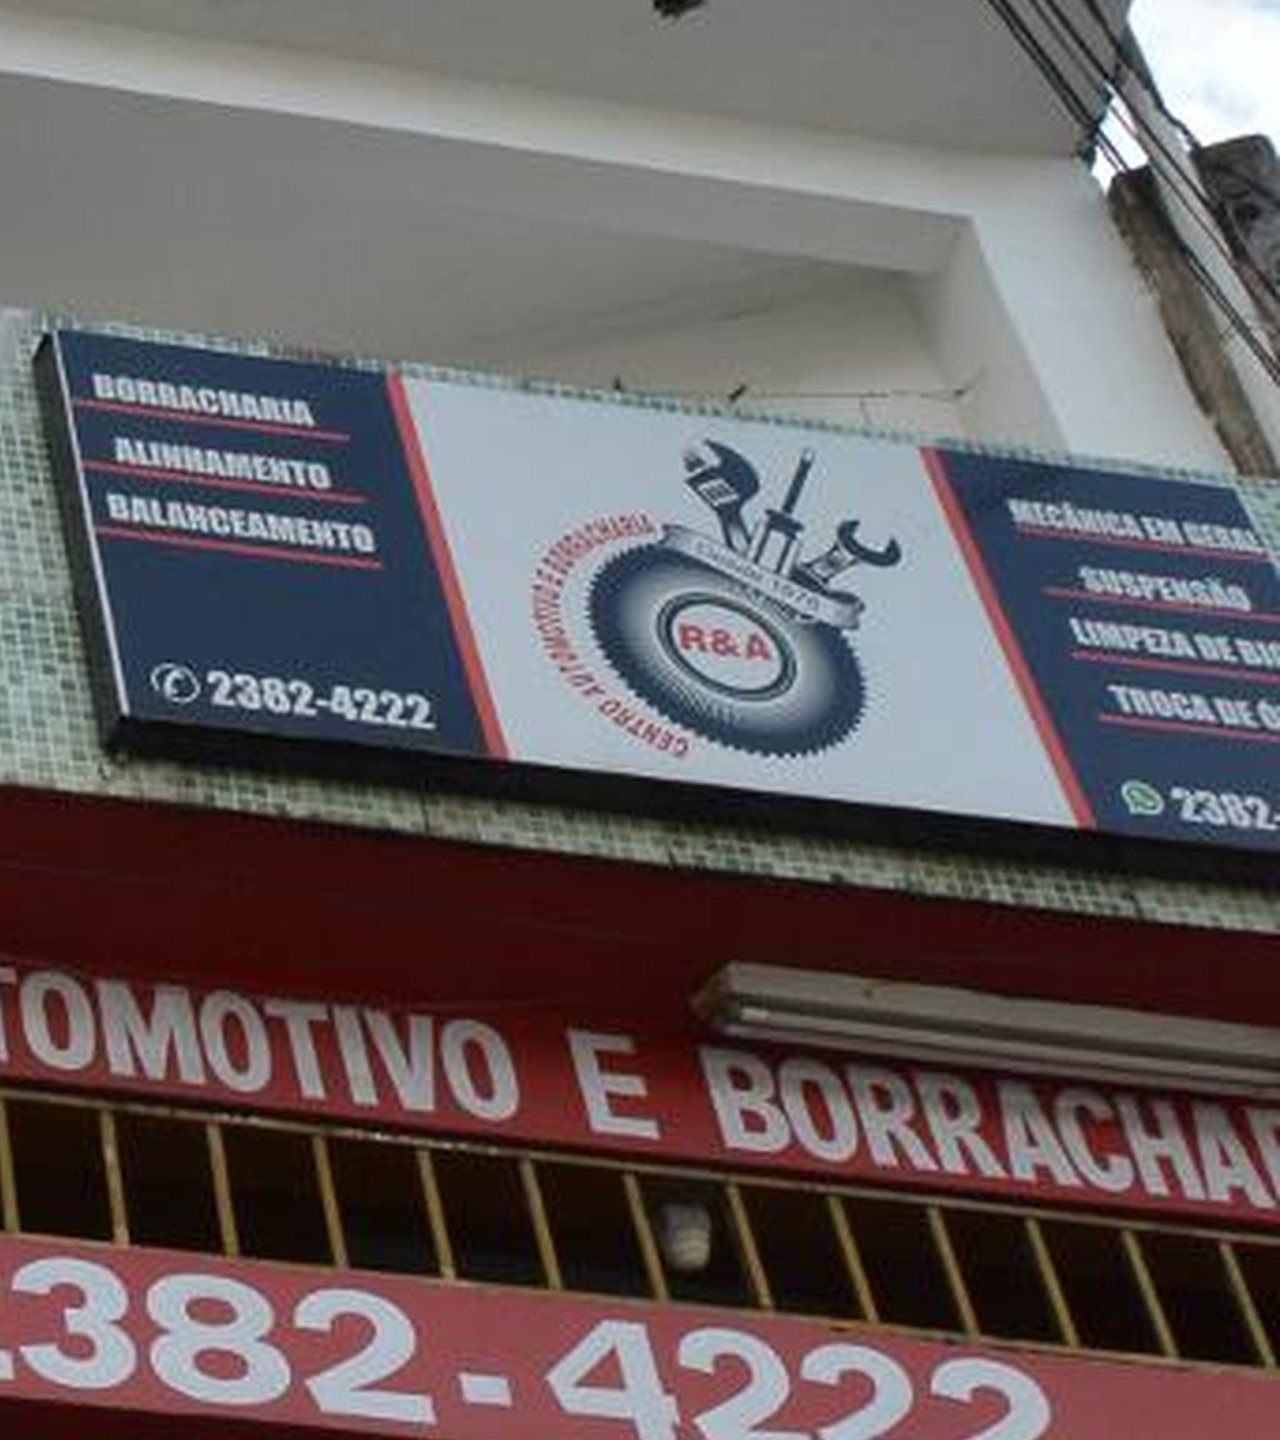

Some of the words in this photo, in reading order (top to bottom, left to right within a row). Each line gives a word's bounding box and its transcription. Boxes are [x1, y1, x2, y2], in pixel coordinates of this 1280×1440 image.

[93, 374, 315, 427] BORRACHARIA
[114, 437, 332, 490] ALINHAMENTO
[106, 493, 376, 553] BALANCEAMENTO
[1140, 515, 1184, 545] EM
[1079, 565, 1251, 611] SUSPENSÃO
[1069, 617, 1195, 658] LIMPEZA
[1193, 632, 1239, 662] DE
[206, 670, 436, 730] 2382-4222
[1107, 684, 1220, 723] TROCA
[1213, 696, 1260, 730] DE
[566, 1028, 661, 1140] E
